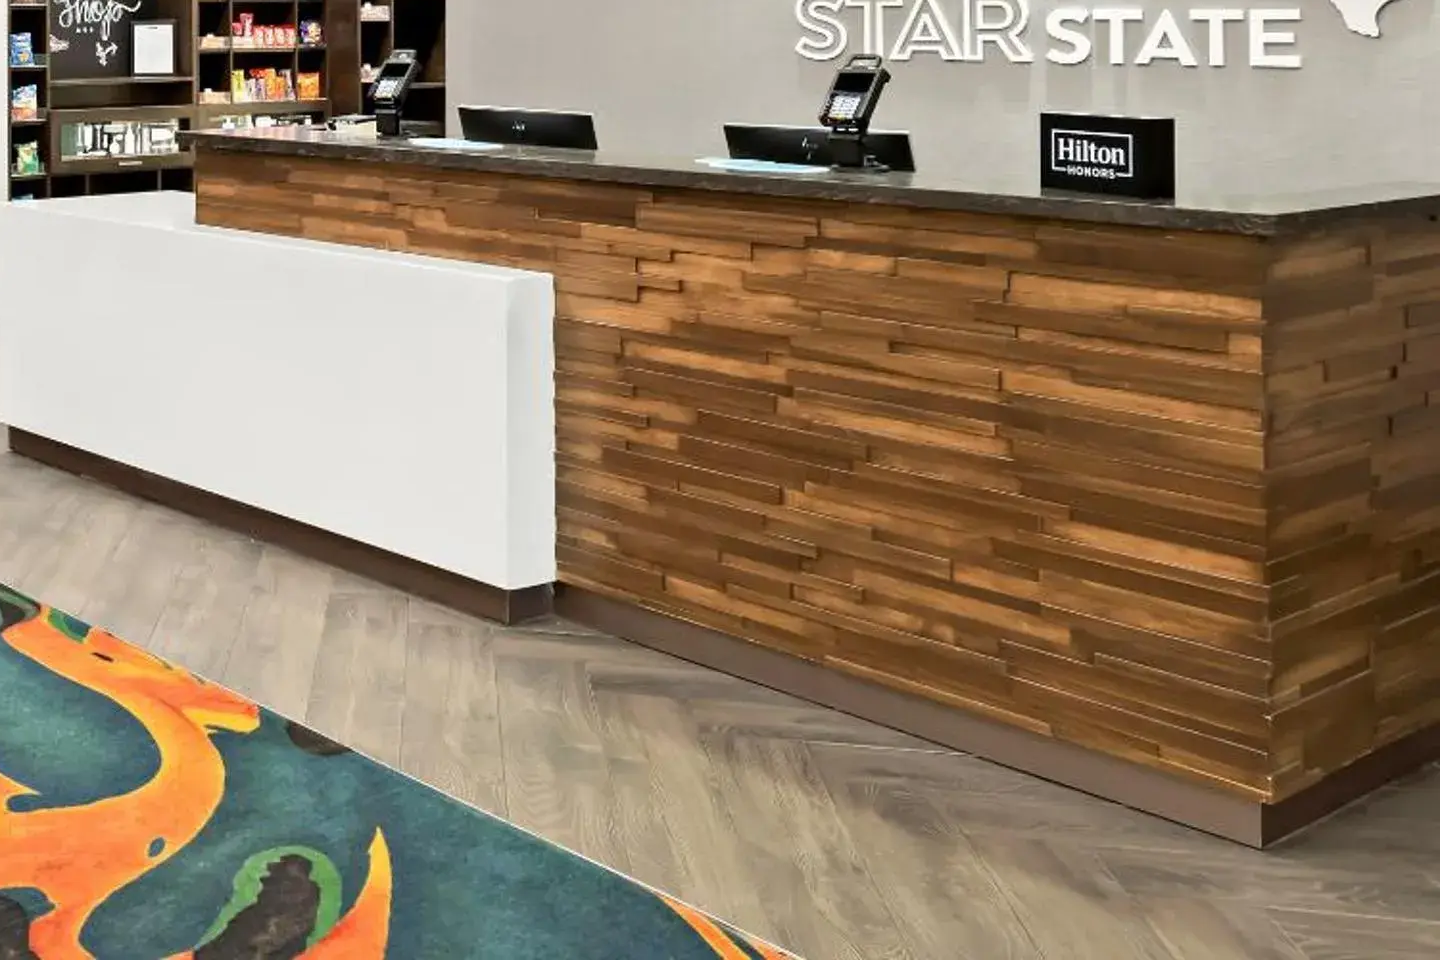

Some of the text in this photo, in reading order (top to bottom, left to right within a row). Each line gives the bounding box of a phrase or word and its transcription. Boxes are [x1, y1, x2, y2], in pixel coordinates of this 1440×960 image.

[1044, 7, 1303, 69] STATE
[1057, 138, 1126, 166] Hilton
[1066, 165, 1116, 179] HONORS
